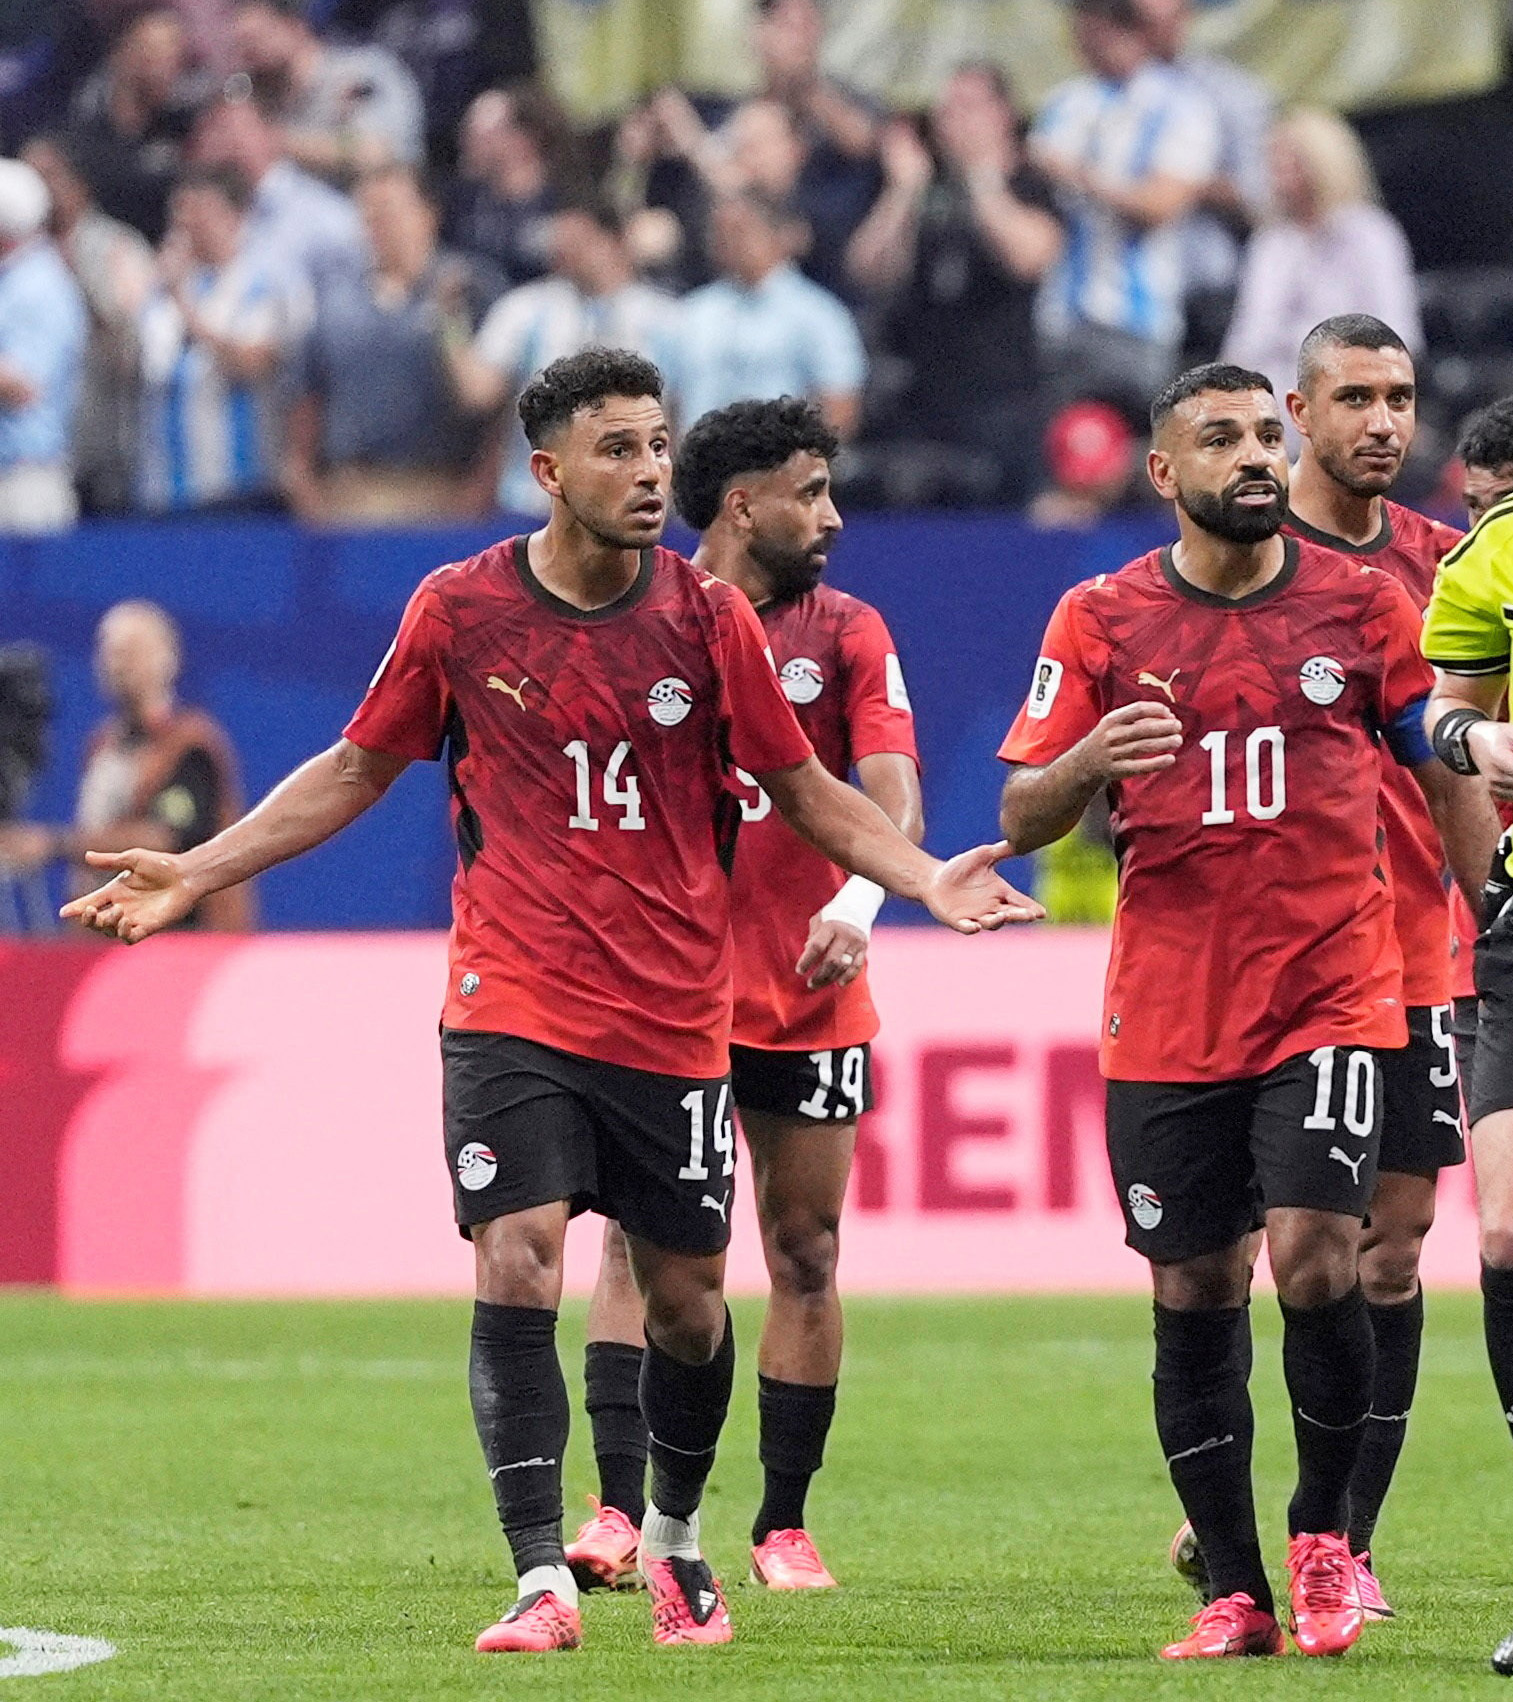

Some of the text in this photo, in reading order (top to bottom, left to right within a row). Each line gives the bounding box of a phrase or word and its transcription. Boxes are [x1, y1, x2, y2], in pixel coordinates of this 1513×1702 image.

[563, 739, 646, 832] 14
[1199, 725, 1287, 826] 10
[798, 1047, 864, 1119] 19
[1303, 1045, 1375, 1138] 10
[1429, 1004, 1458, 1088] 5
[678, 1083, 735, 1181] 14
